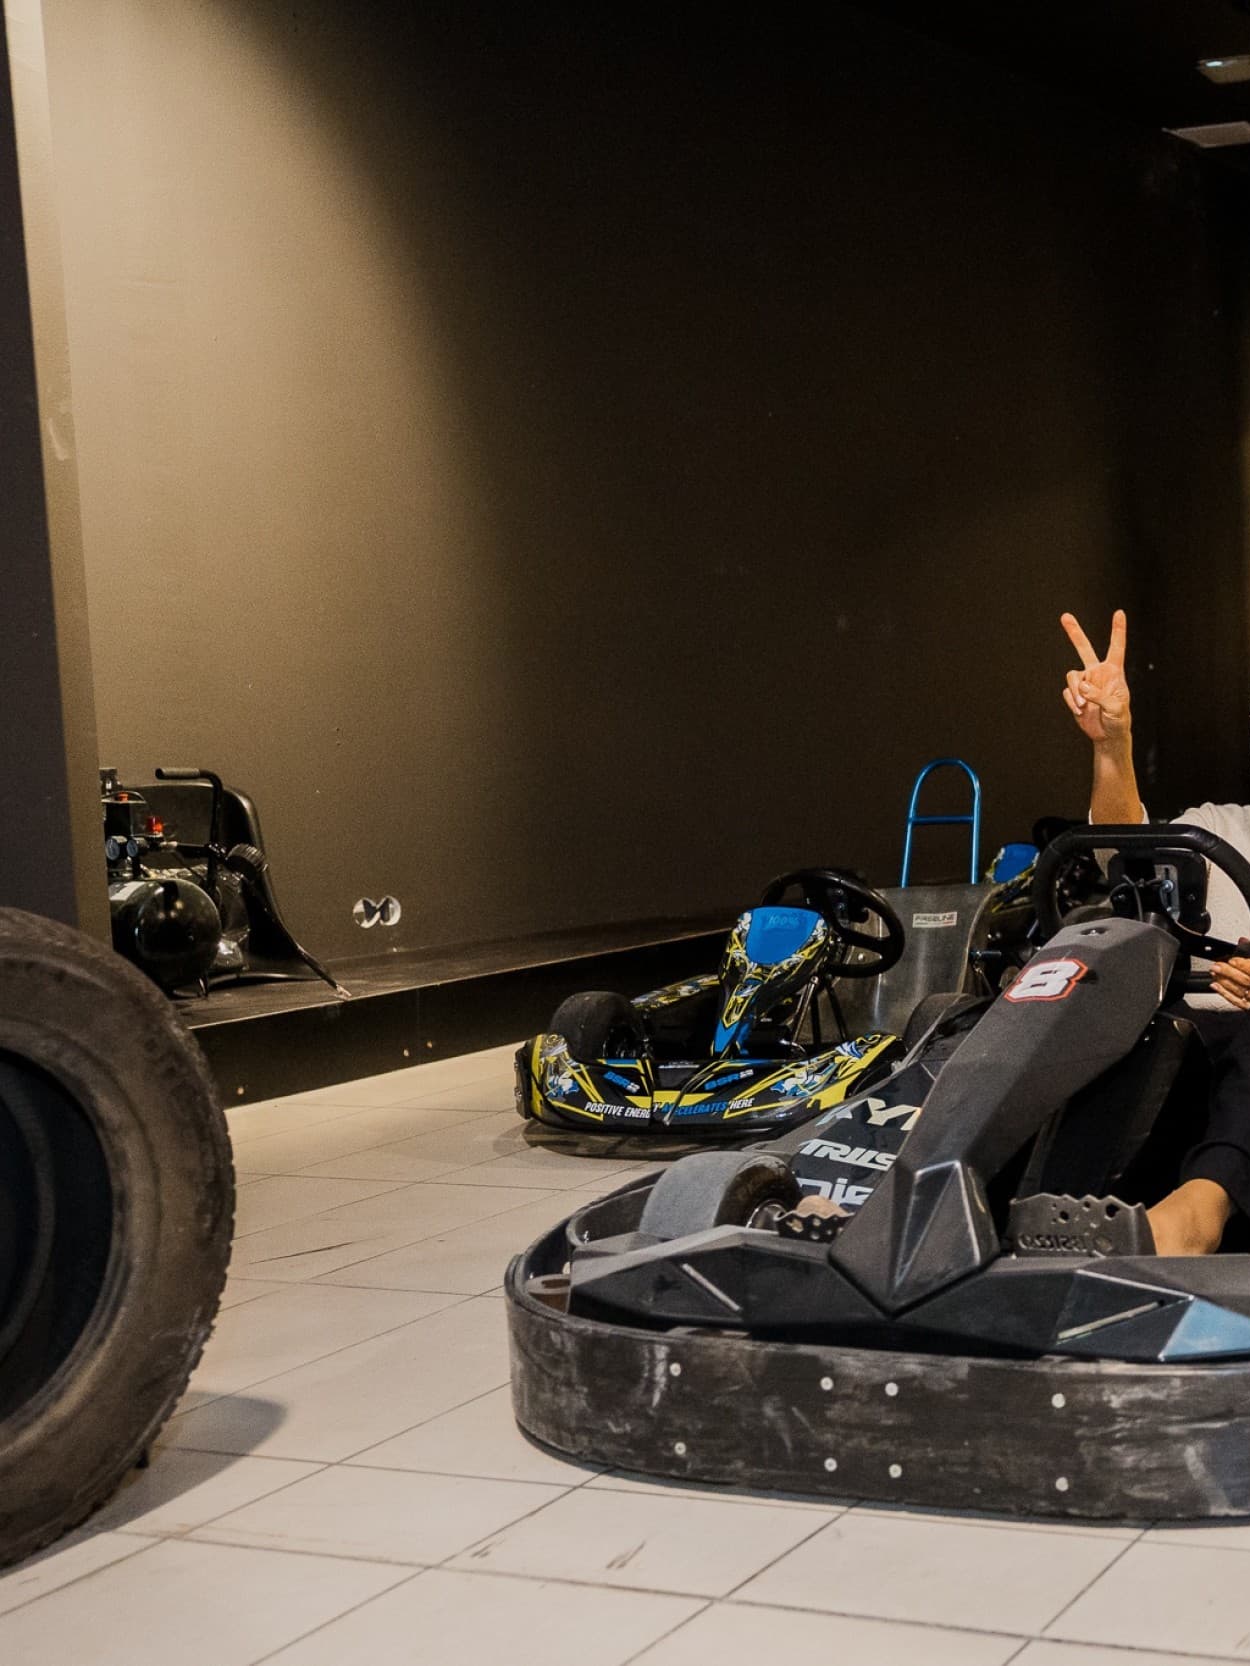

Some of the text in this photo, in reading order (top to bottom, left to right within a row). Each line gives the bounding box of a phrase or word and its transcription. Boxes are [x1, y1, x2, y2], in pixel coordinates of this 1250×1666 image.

[1008, 961, 1080, 999] 8
[584, 1101, 624, 1116] POSITIVE
[728, 1097, 755, 1109] HERE
[798, 1138, 897, 1171] TRUS
